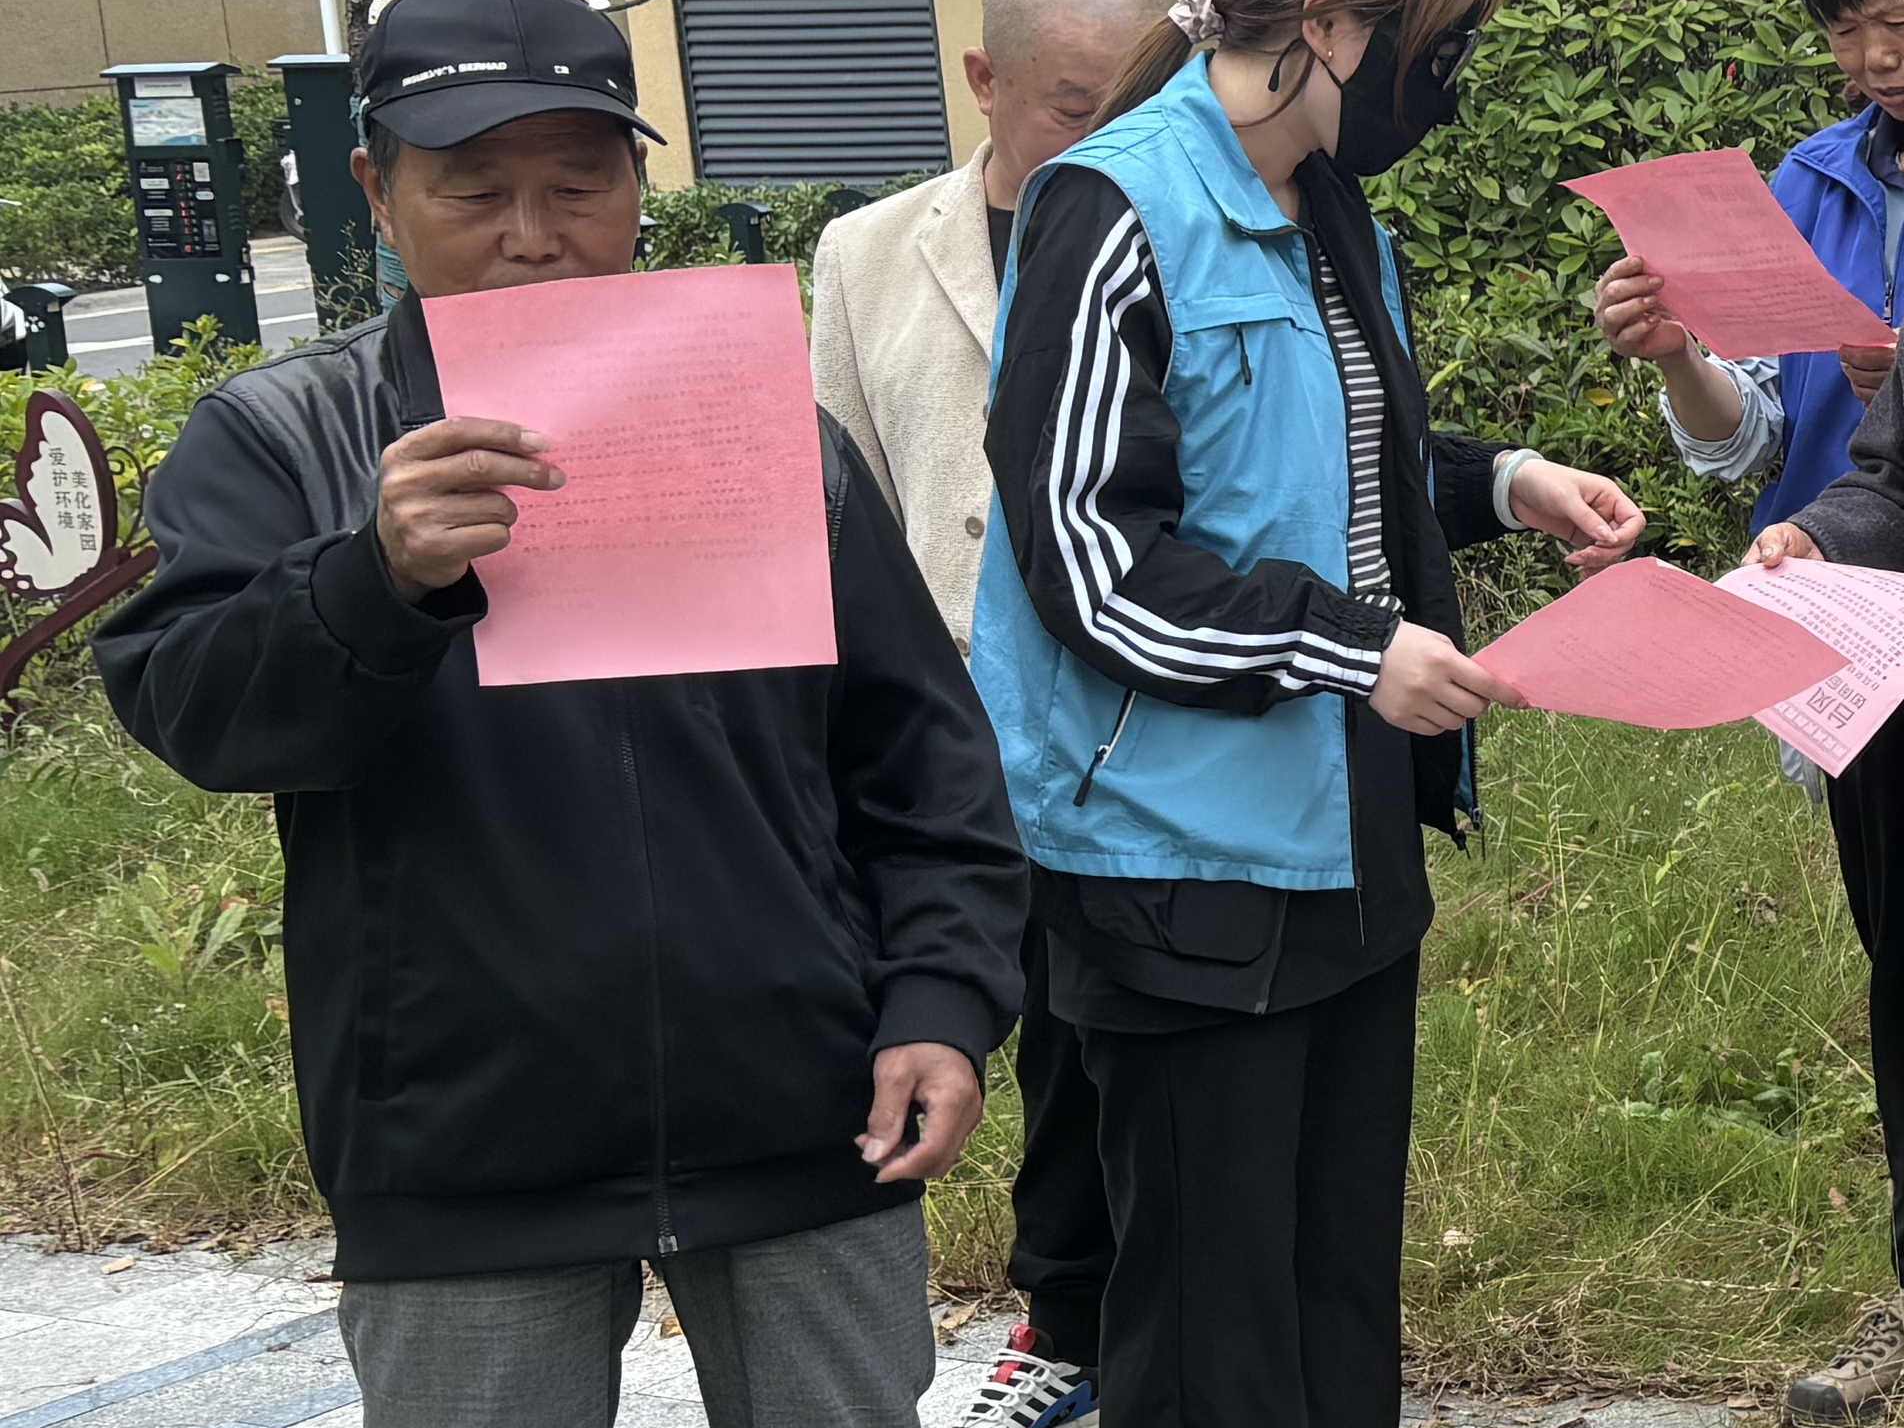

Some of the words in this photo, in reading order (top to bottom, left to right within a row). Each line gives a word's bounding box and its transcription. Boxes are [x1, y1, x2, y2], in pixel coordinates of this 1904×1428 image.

[48, 446, 76, 530] 爱护环境
[71, 469, 98, 552] 美化家园
